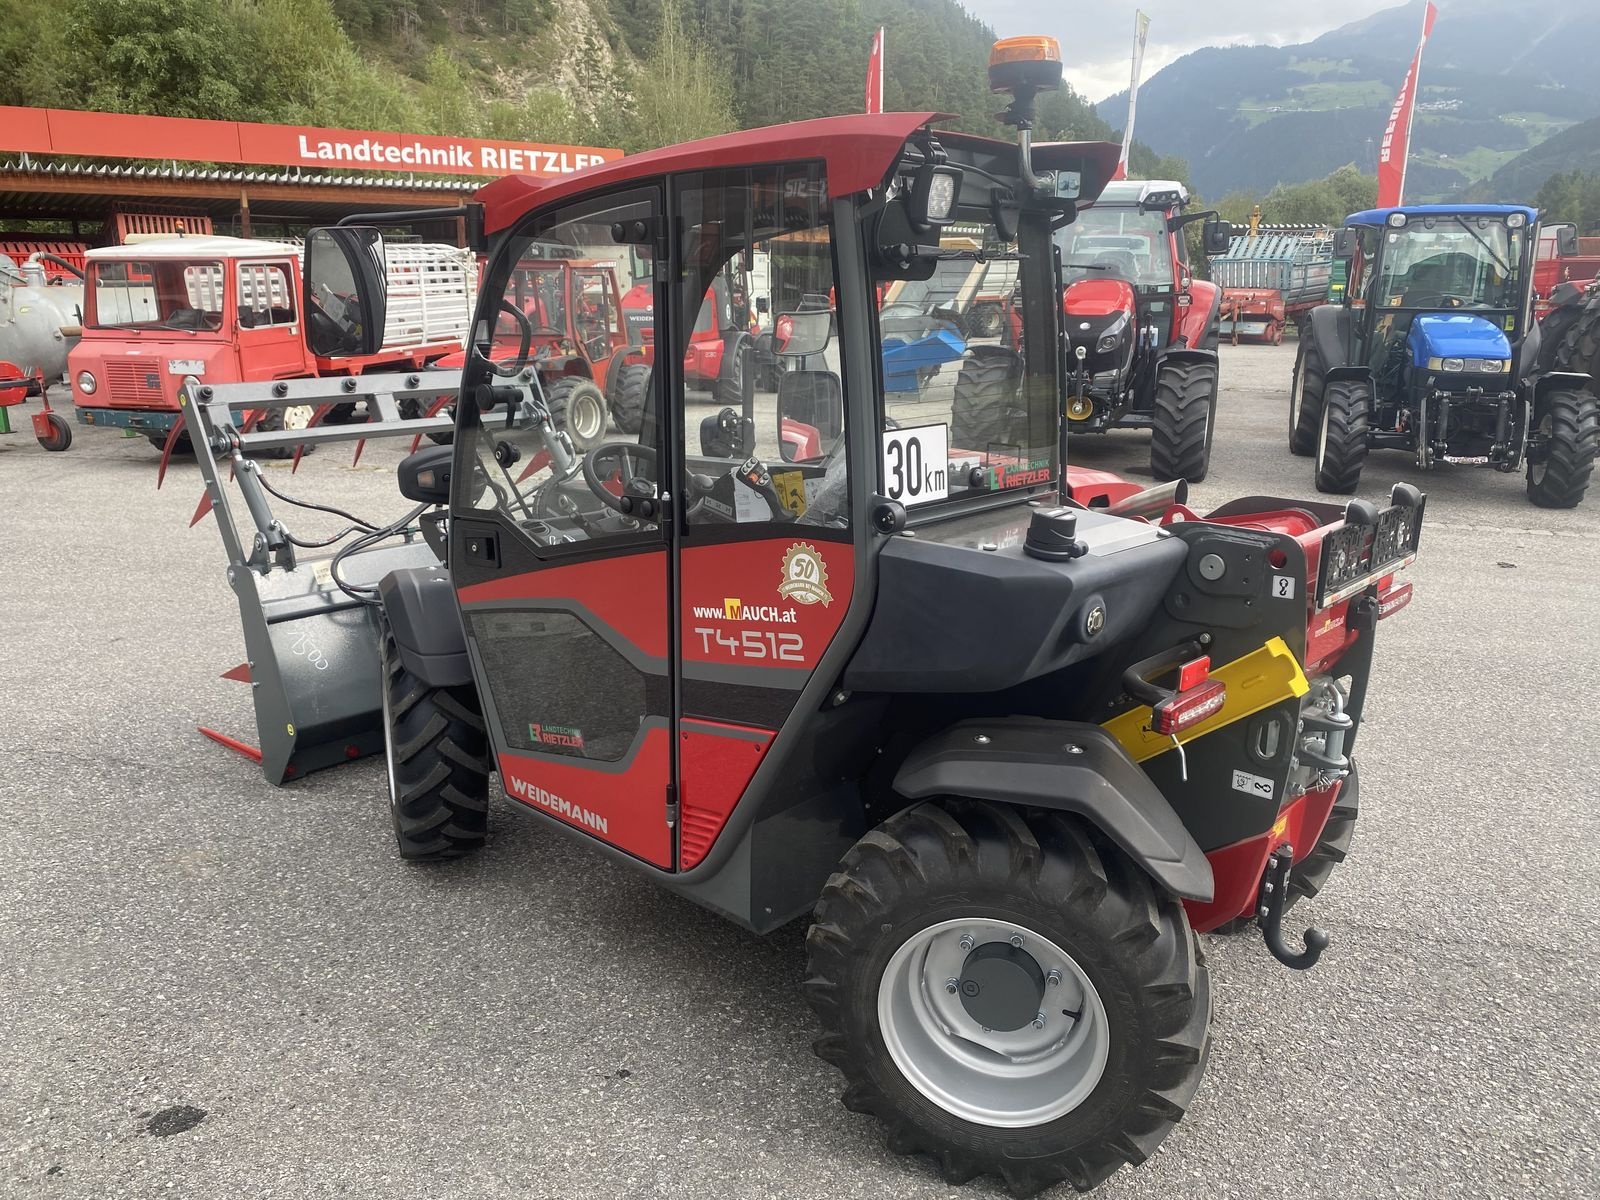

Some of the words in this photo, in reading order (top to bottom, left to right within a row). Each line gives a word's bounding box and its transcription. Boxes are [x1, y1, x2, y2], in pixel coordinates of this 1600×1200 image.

[298, 135, 474, 168] Landtechnik
[481, 147, 606, 173] RIETZLER
[887, 436, 922, 500] 30
[925, 462, 945, 494] km
[1006, 468, 1050, 488] RIETZLER
[794, 558, 814, 579] 50
[693, 603, 797, 623] www.MAUCH.at
[695, 627, 805, 661] T4512
[542, 733, 585, 749] RIETZLER
[511, 775, 608, 834] WEIDEMANN
